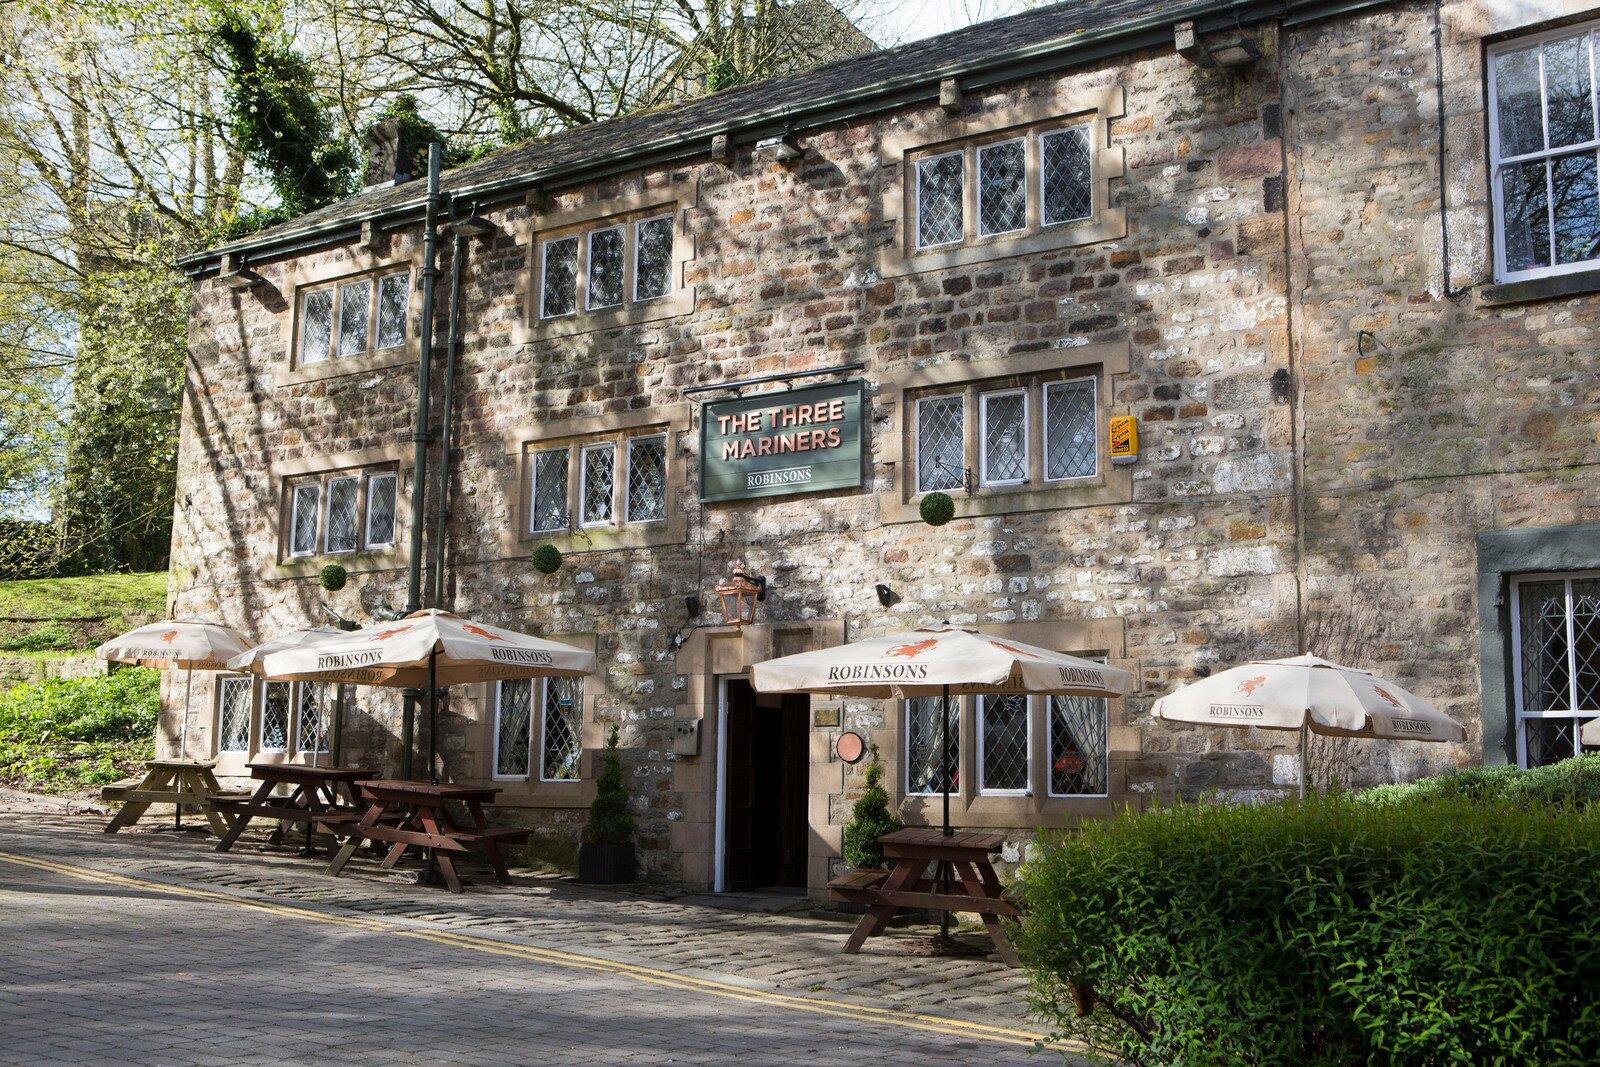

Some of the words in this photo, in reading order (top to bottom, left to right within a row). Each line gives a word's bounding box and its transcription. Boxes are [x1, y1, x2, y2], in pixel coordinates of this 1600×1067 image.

[717, 411, 763, 435] THE
[768, 400, 845, 428] THREE
[722, 427, 842, 461] MARINERS
[747, 467, 812, 487] ROBINSONS
[318, 651, 383, 669] ROBINSONS
[491, 648, 553, 664] ROBINSONS
[828, 664, 928, 680] ROBINSONS
[1059, 667, 1105, 685] ROBINSONS
[1209, 705, 1264, 718] ROBINSONS
[1391, 719, 1432, 733] ROBINSONS
